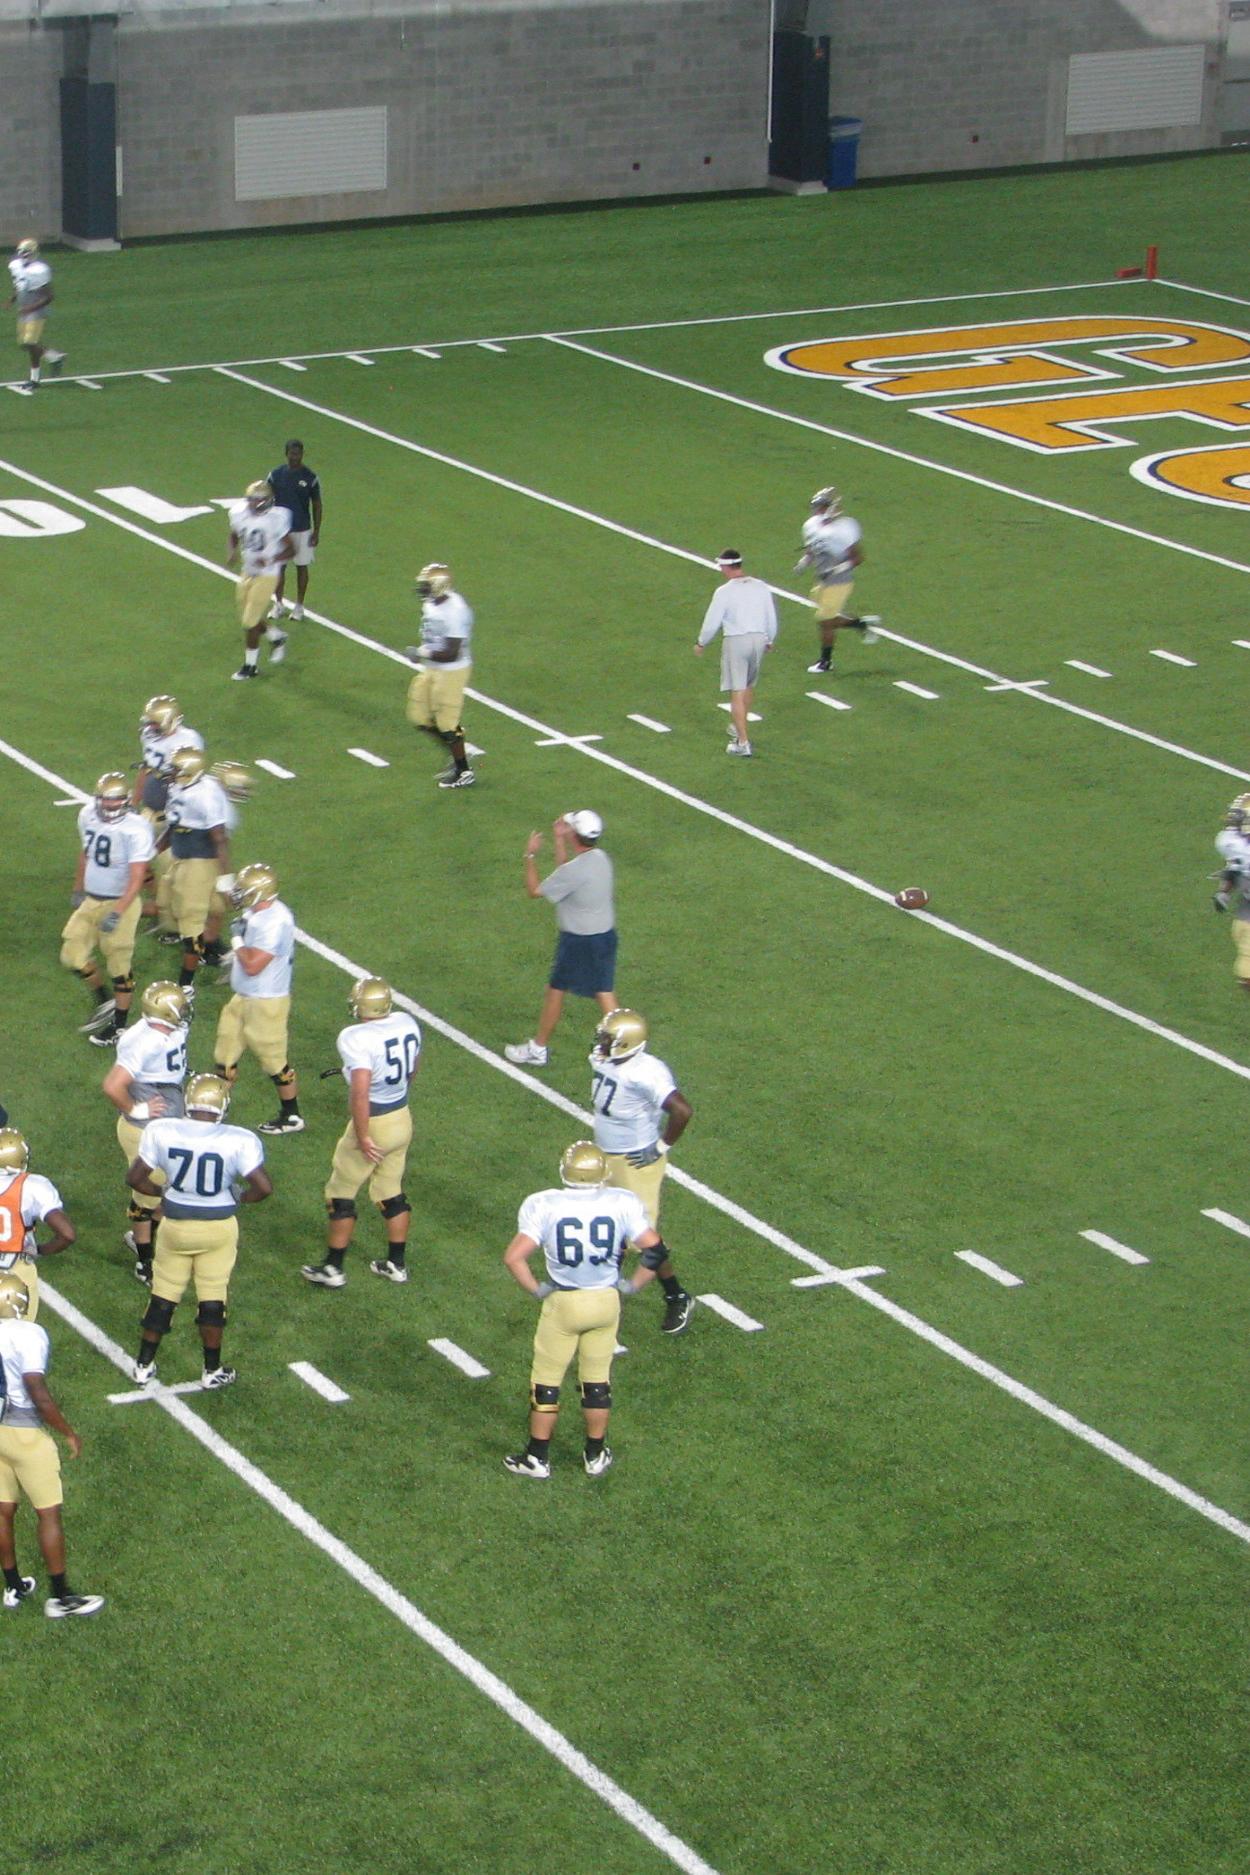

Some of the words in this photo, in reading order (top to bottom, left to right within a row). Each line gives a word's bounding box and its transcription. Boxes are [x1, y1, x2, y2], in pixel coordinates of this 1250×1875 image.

[85, 829, 112, 868] 78
[384, 1033, 420, 1085] 50
[592, 1070, 619, 1117] 77
[167, 1147, 224, 1197] 70
[555, 1215, 616, 1268] 69
